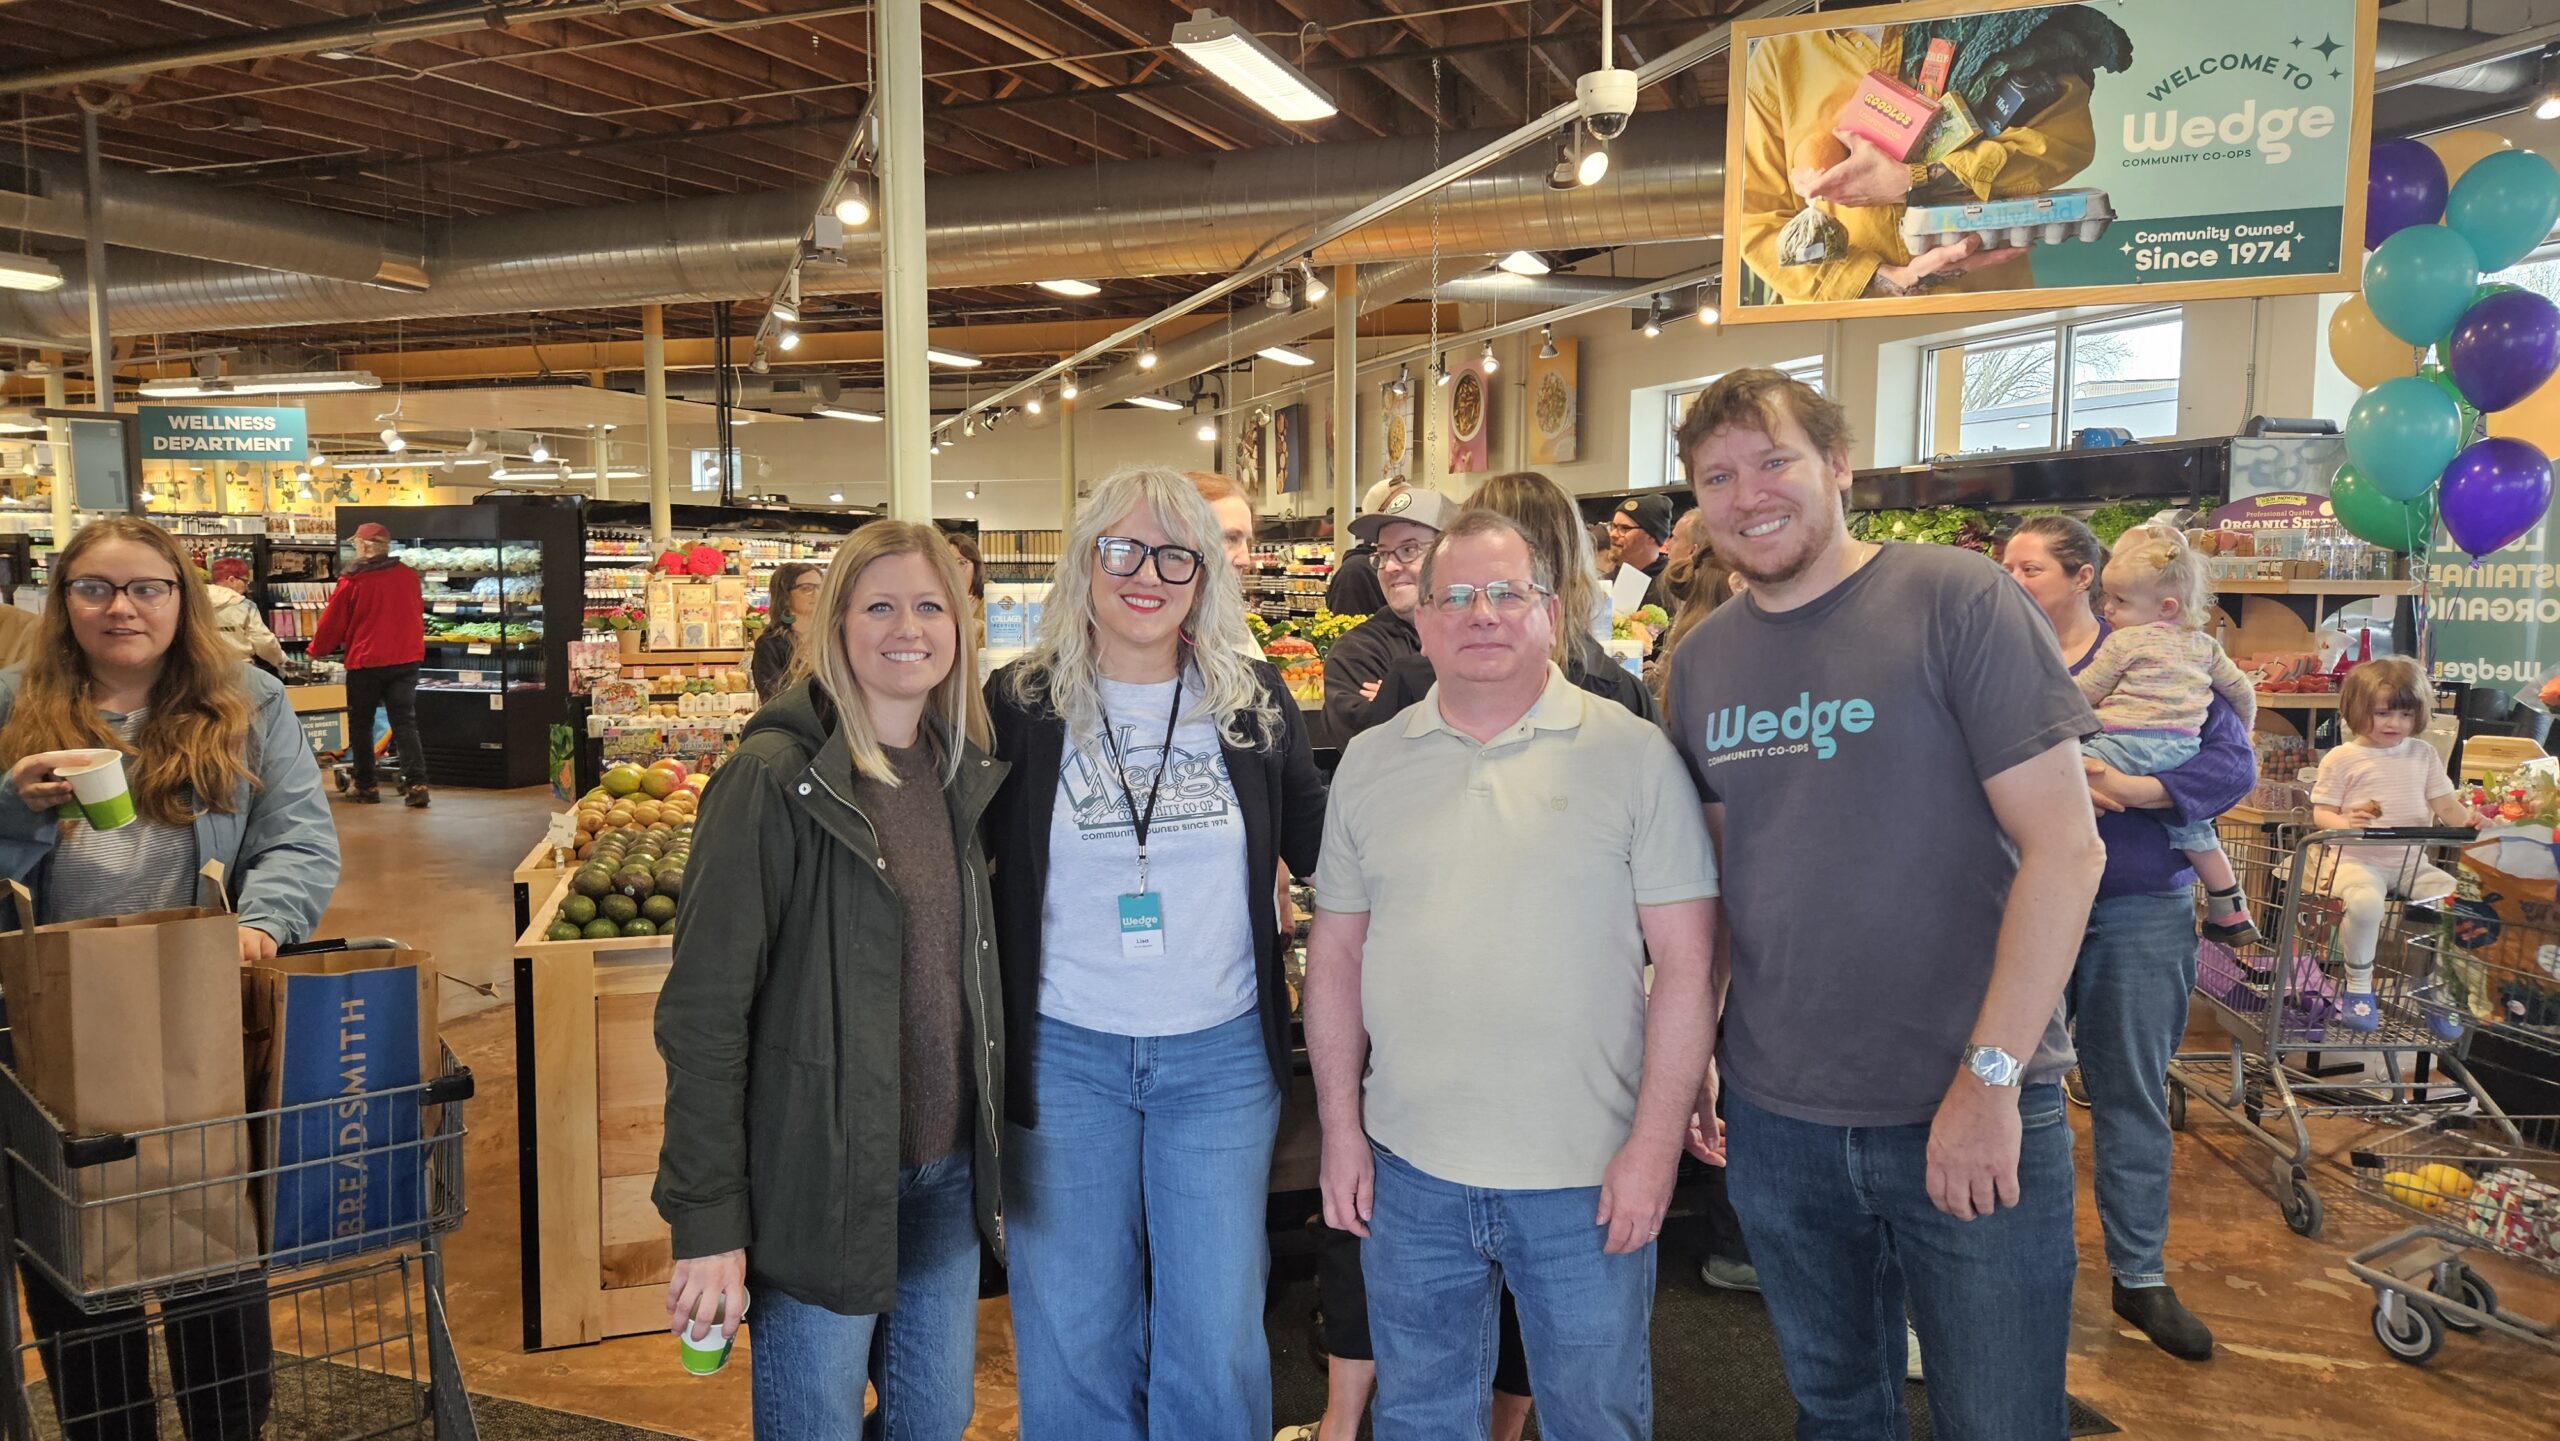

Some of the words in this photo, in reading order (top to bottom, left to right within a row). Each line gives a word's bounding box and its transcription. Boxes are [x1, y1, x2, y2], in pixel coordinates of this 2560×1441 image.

[2146, 53, 2280, 101] WELCOME
[2282, 63, 2313, 90] TO
[2122, 99, 2335, 165] Wedge
[2122, 153, 2199, 168] COMMUNITY
[2202, 149, 2252, 161] CO-OPS
[2135, 226, 2230, 244] Community
[2234, 221, 2295, 237] Owned
[2135, 246, 2219, 271] Since
[2228, 240, 2292, 265] 1974
[167, 415, 277, 431] WELLNESS
[153, 436, 294, 453] DEPARTMENT
[2220, 518, 2289, 529] ORGANIC
[2246, 510, 2287, 518] Professional
[2288, 509, 2315, 517] Quality
[308, 729, 328, 738] HERE
[1706, 691, 1875, 760] Wedge
[1707, 748, 1765, 767] COMMUNITY
[1767, 743, 1809, 756] CO-OPS
[1059, 724, 1231, 813] Wedge
[1183, 800, 1214, 813] CO-OP
[1081, 829, 1136, 841] COMMUNIT
[1182, 820, 1209, 831] SINCE
[1211, 818, 1228, 828] 1974
[1122, 915, 1159, 929] Wedge
[336, 998, 369, 1239] BREADSMITH
